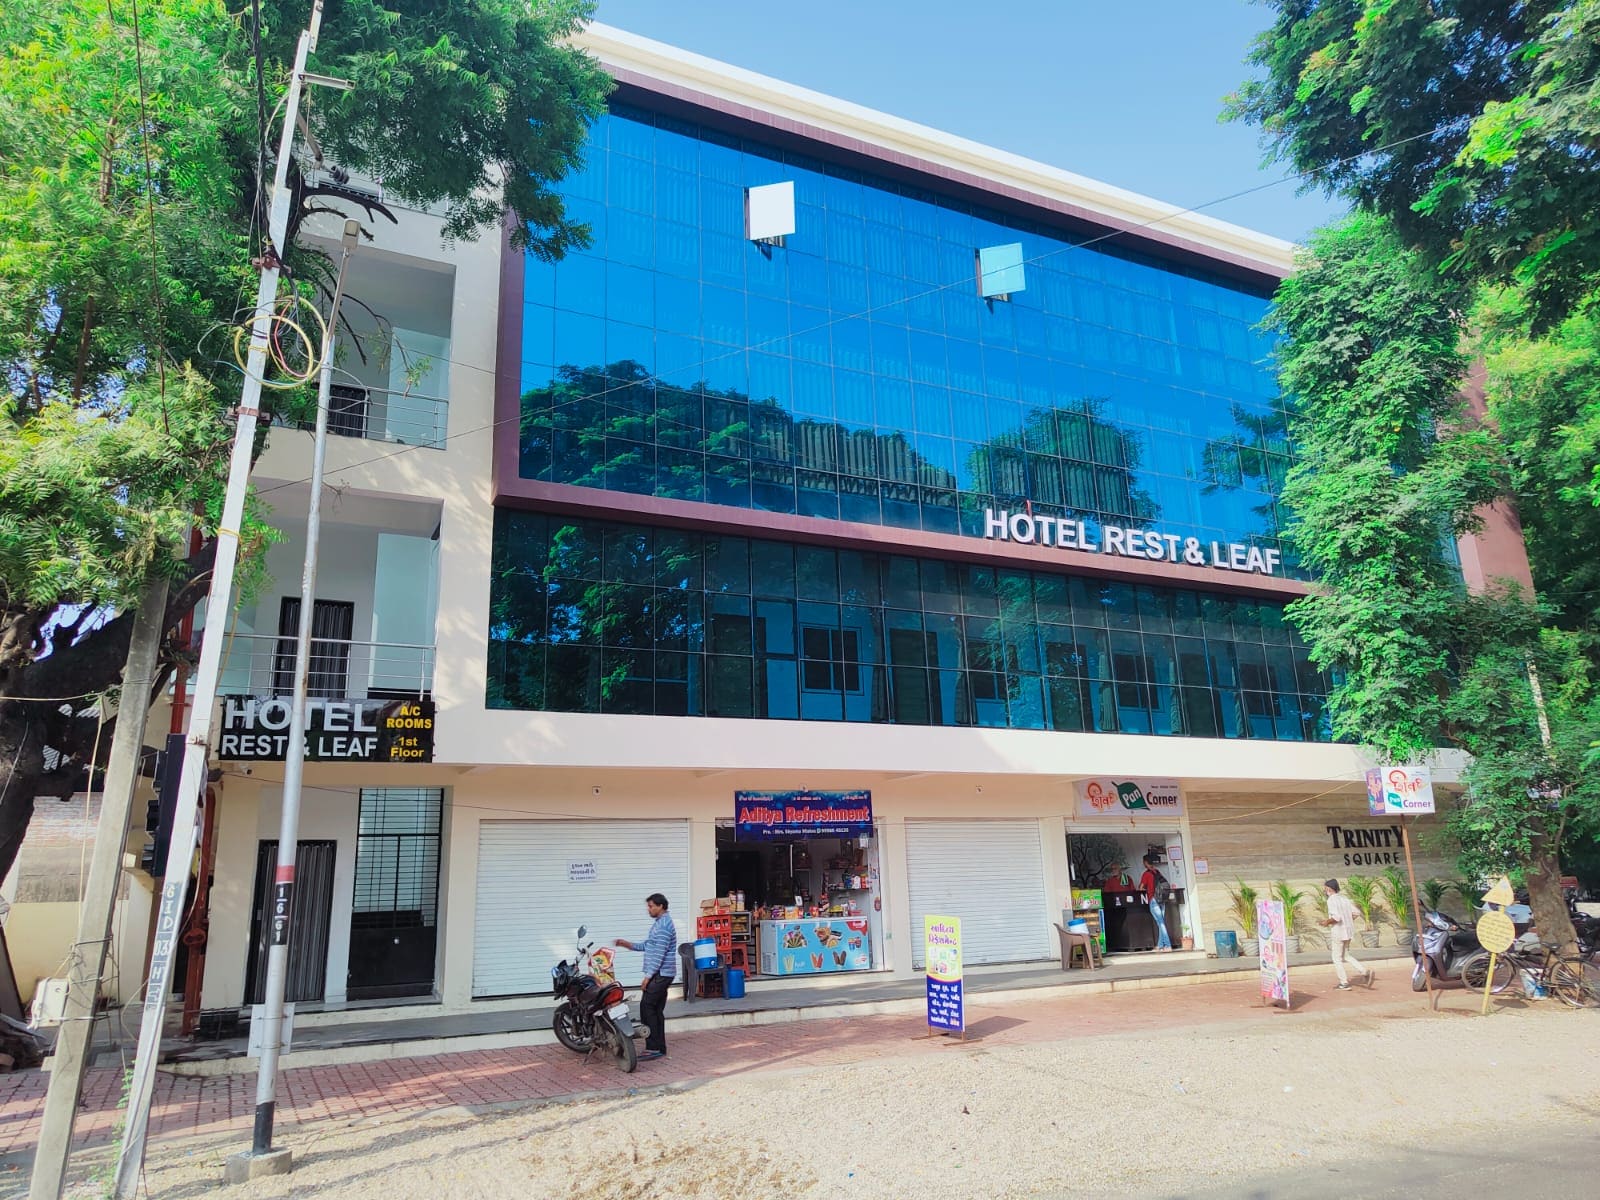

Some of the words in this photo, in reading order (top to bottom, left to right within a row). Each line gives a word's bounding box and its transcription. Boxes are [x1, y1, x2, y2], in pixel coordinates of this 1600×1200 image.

[984, 508, 1097, 551] HOTEL
[1103, 524, 1181, 562] REST
[1183, 537, 1205, 566] &
[1211, 541, 1280, 574] LEAF
[224, 699, 377, 732] HOTEL
[399, 706, 421, 716] A/C
[386, 718, 433, 729] ROOMS
[221, 735, 288, 756] REST
[318, 737, 378, 757] LEAF
[398, 737, 418, 747] 1st
[390, 747, 424, 758] Floor
[1122, 788, 1141, 807] Pan
[1146, 791, 1178, 806] Corner
[1403, 799, 1431, 808] Corner
[739, 806, 783, 826] Aditya
[785, 805, 870, 823] Refreshment
[1327, 825, 1405, 848] TRINITY
[1343, 852, 1400, 866] SQUARE
